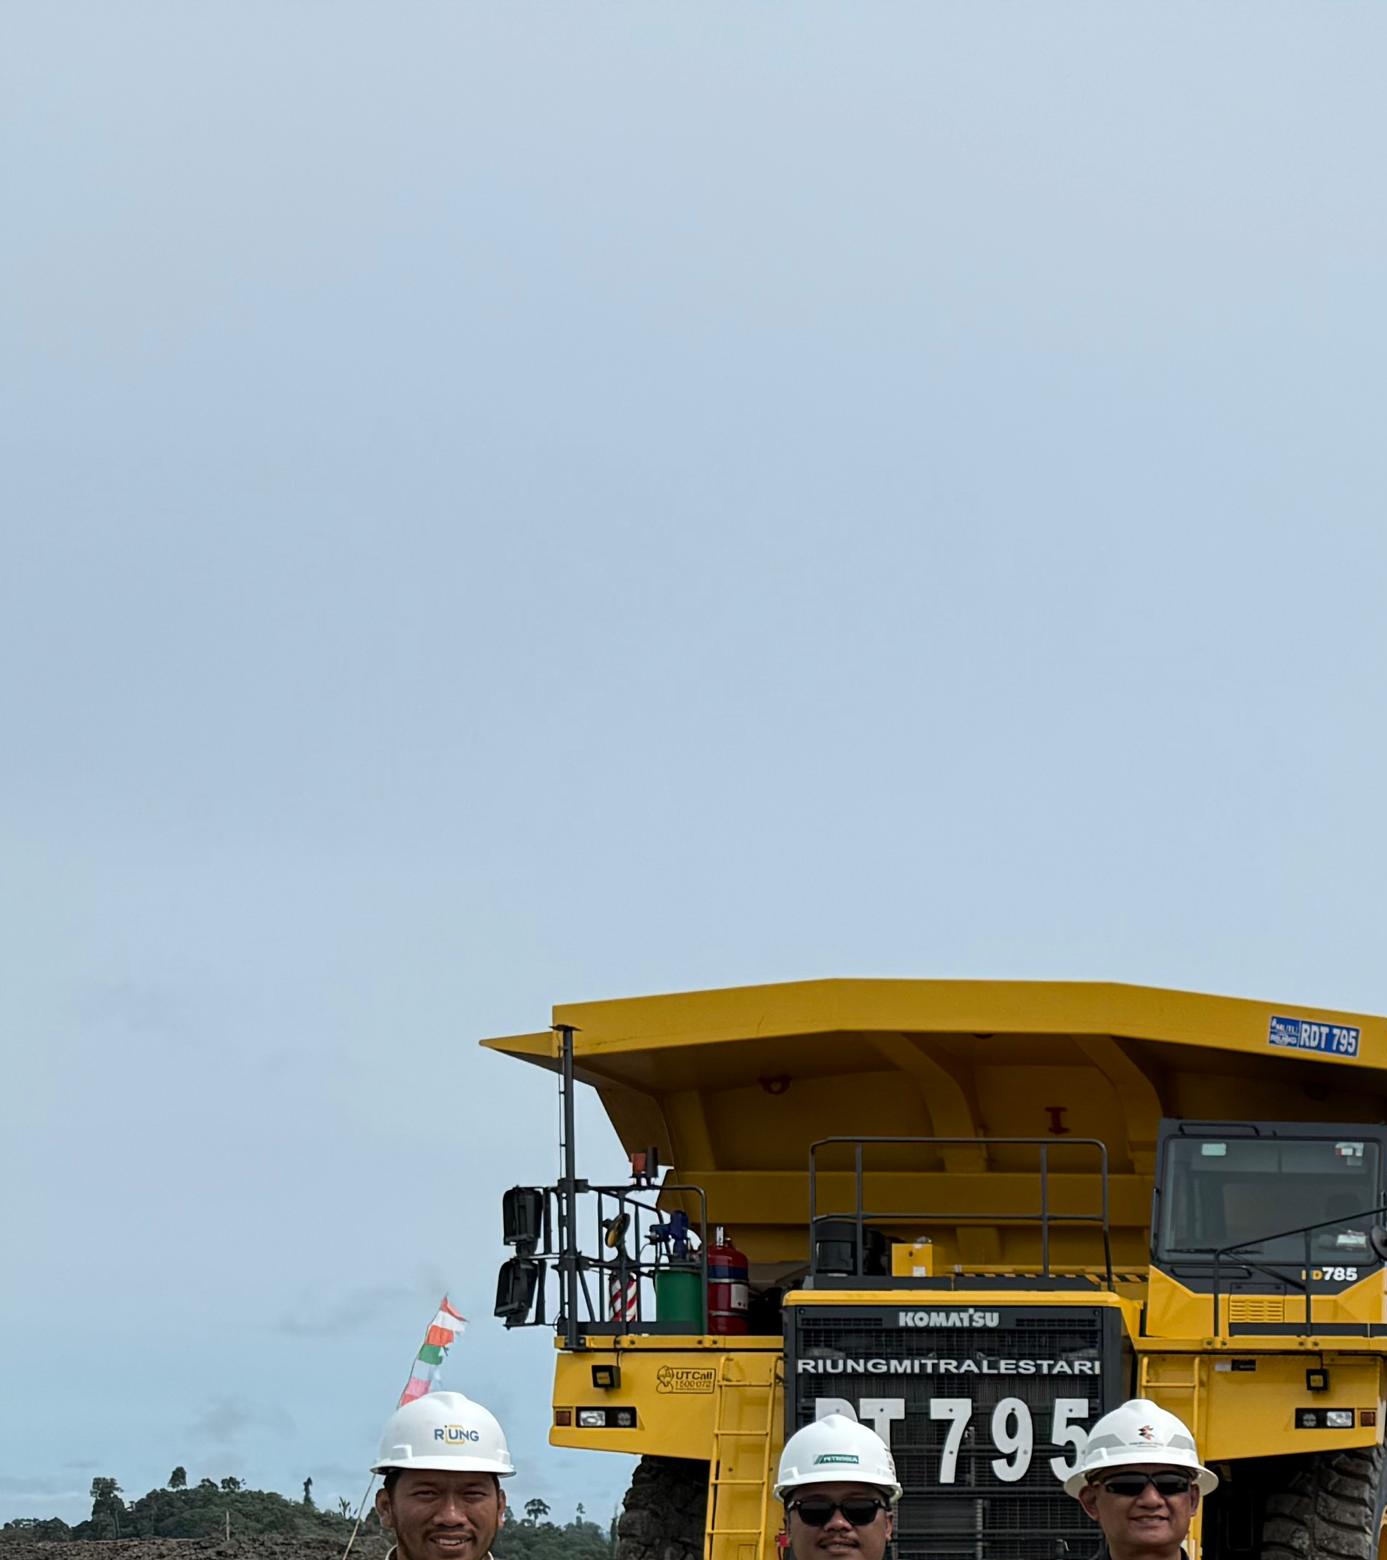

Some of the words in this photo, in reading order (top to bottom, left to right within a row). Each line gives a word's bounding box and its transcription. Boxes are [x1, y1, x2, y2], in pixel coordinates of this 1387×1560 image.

[1300, 1023, 1330, 1049] RDT
[1331, 1028, 1358, 1053] 795
[899, 1308, 999, 1327] KOMATSU
[797, 1358, 1101, 1375] RIUNGMITRALESTARI
[930, 1397, 1094, 1483] 795
